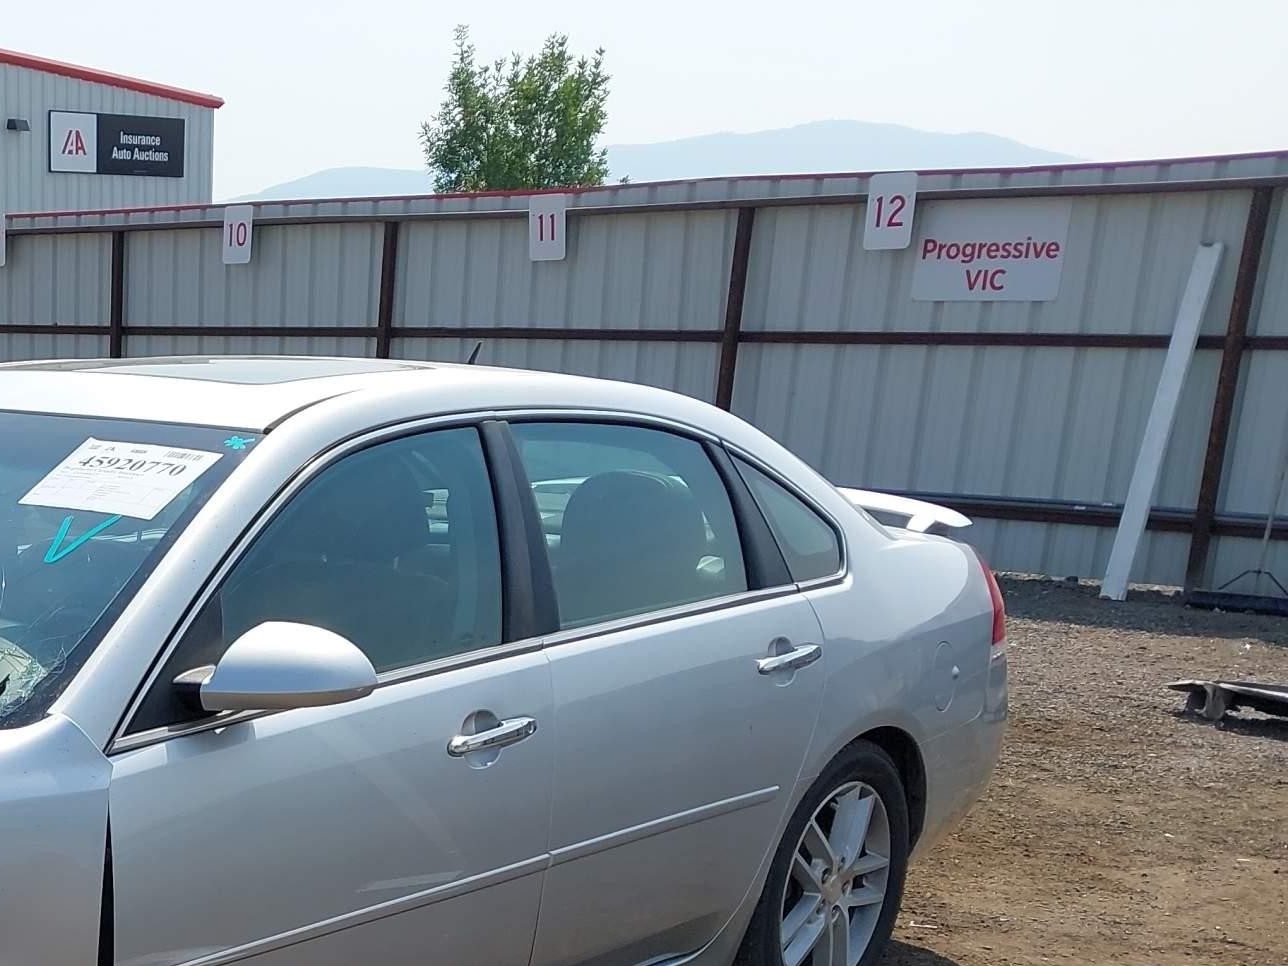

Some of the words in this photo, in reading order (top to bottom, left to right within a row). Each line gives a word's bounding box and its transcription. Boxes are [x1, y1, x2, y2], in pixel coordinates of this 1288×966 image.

[120, 131, 161, 146] Insurance
[112, 146, 132, 160] Auto
[133, 148, 169, 162] Auctions
[874, 194, 906, 228] 12
[228, 222, 247, 247] 10
[538, 213, 555, 242] 11
[922, 237, 1060, 264] Progressive
[965, 268, 1007, 291] VIC
[78, 455, 187, 477] 45920770
